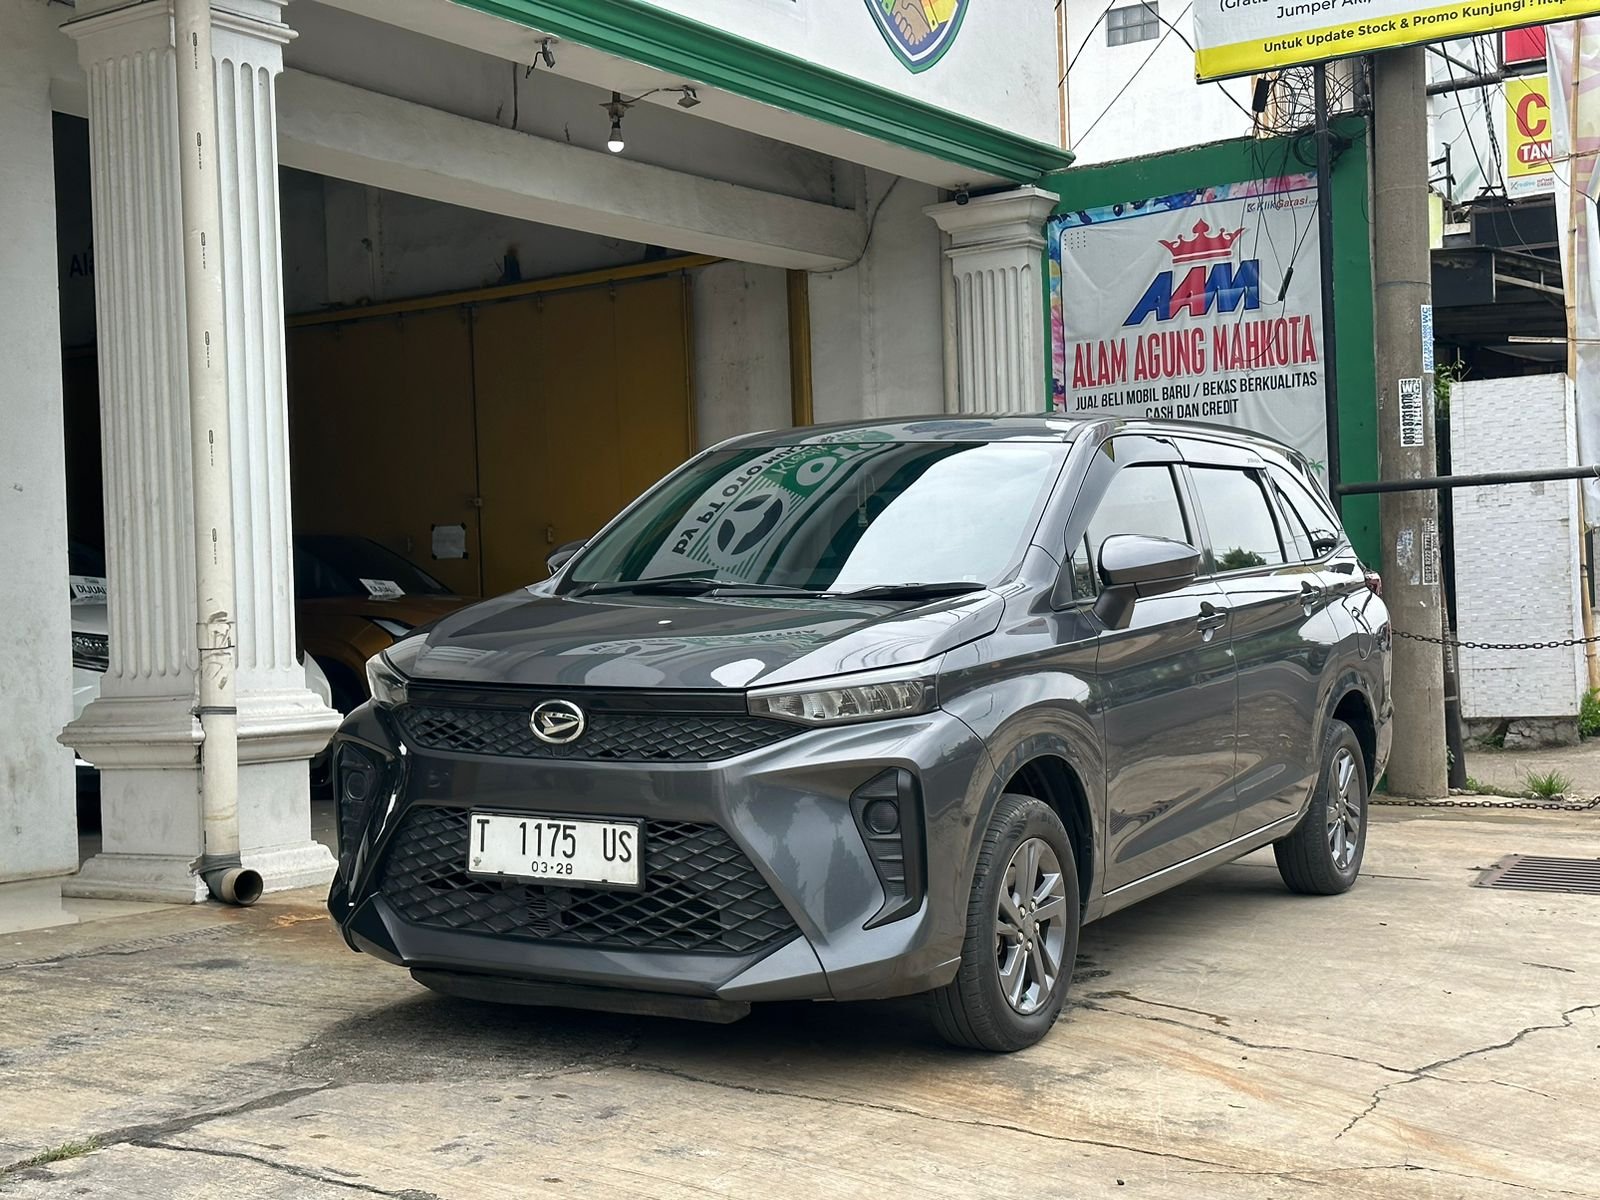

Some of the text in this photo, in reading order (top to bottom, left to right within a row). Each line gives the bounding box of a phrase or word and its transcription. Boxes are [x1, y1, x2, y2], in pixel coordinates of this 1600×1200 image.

[1276, 0, 1336, 19] Jumper
[1264, 37, 1303, 53] Untuk
[1306, 27, 1355, 46] Update
[1358, 20, 1397, 36] Stock
[1400, 18, 1410, 29] &
[1413, 11, 1459, 27] Promo
[1122, 258, 1259, 327] AAM
[1072, 314, 1318, 389] ALAM AGUNG MAHKOTA
[1076, 371, 1318, 411] JUAL BELI MOBIL BARU / BEKAS BERKUALITAS
[1402, 383, 1420, 393] WC
[1146, 399, 1239, 419] CASH DAN CREDIT
[1402, 410, 1414, 426] 8731
[1402, 428, 1415, 445] 0813
[477, 819, 632, 863] T 1175 US
